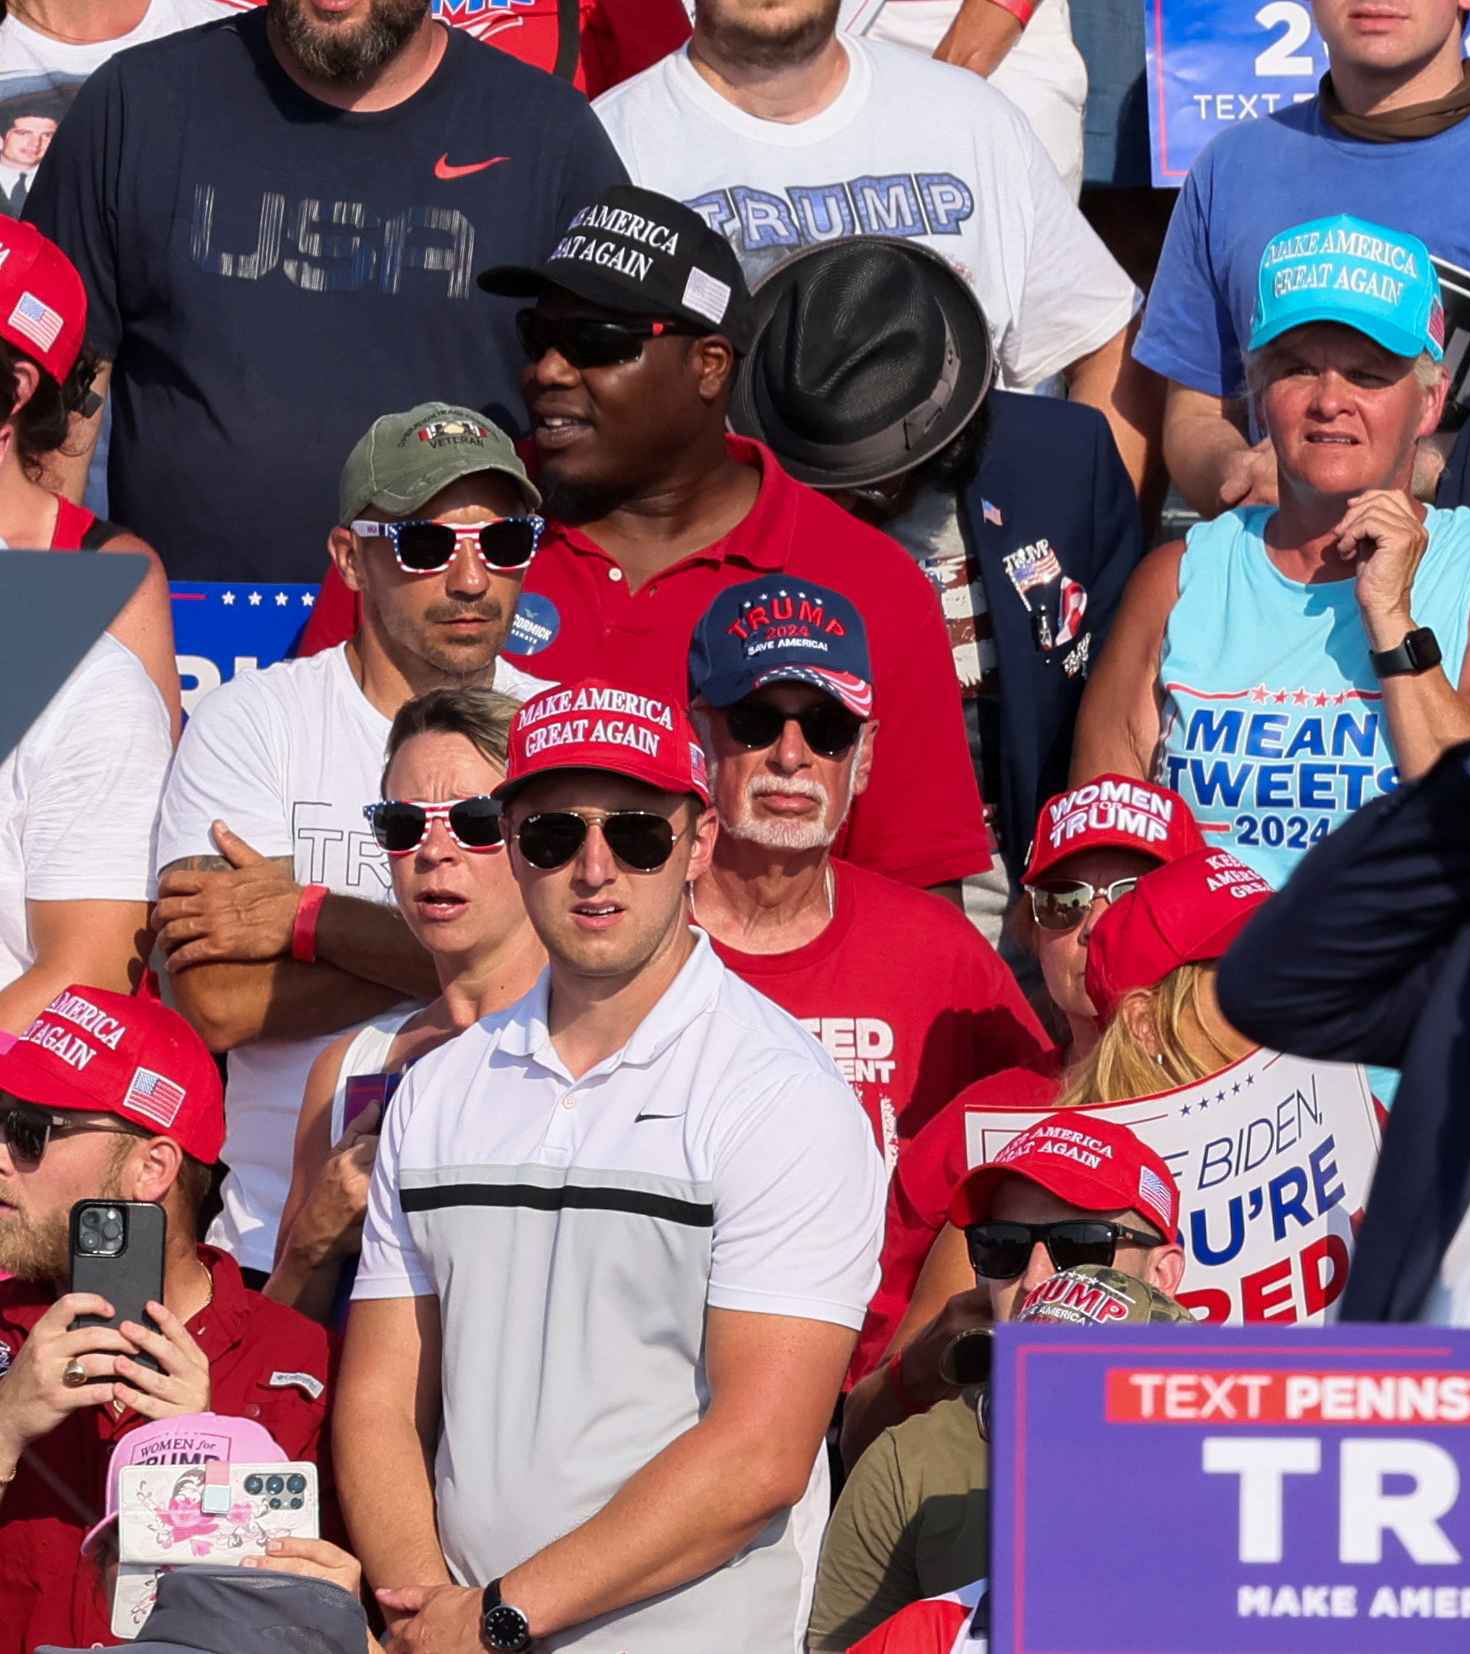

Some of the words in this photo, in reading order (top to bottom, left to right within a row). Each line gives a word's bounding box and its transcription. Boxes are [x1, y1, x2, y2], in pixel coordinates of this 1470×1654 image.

[583, 204, 679, 256] AMERICA
[683, 173, 975, 250] TRUMP
[190, 184, 476, 299] USA
[579, 240, 653, 282] AGAIN
[1264, 233, 1320, 268] MAKE
[1321, 229, 1417, 279] AMERICA
[1274, 263, 1332, 298] GREAT
[1333, 269, 1404, 304] AGAIN
[430, 437, 484, 449] VETERAN
[727, 597, 847, 640] TRUMP
[748, 641, 774, 656] SAVE
[517, 690, 573, 731] MAKE
[572, 688, 673, 731] AMERICA
[526, 719, 588, 758] GREAT
[590, 720, 660, 757] AGAIN
[1186, 709, 1378, 759] MEAN
[1050, 781, 1172, 825] WOMEN
[1050, 807, 1168, 848] TRUMP
[1234, 815, 1330, 850] 2024
[33, 1022, 96, 1070] AGAIN
[1031, 1126, 1113, 1159] AMERICA
[1197, 1073, 1323, 1190] BIDEN,
[1037, 1140, 1101, 1169] AGAIN
[1130, 1374, 1272, 1420] TEXT
[140, 1438, 194, 1457] WOMEN
[196, 1440, 216, 1450] for
[1236, 1585, 1358, 1619] MAKE
